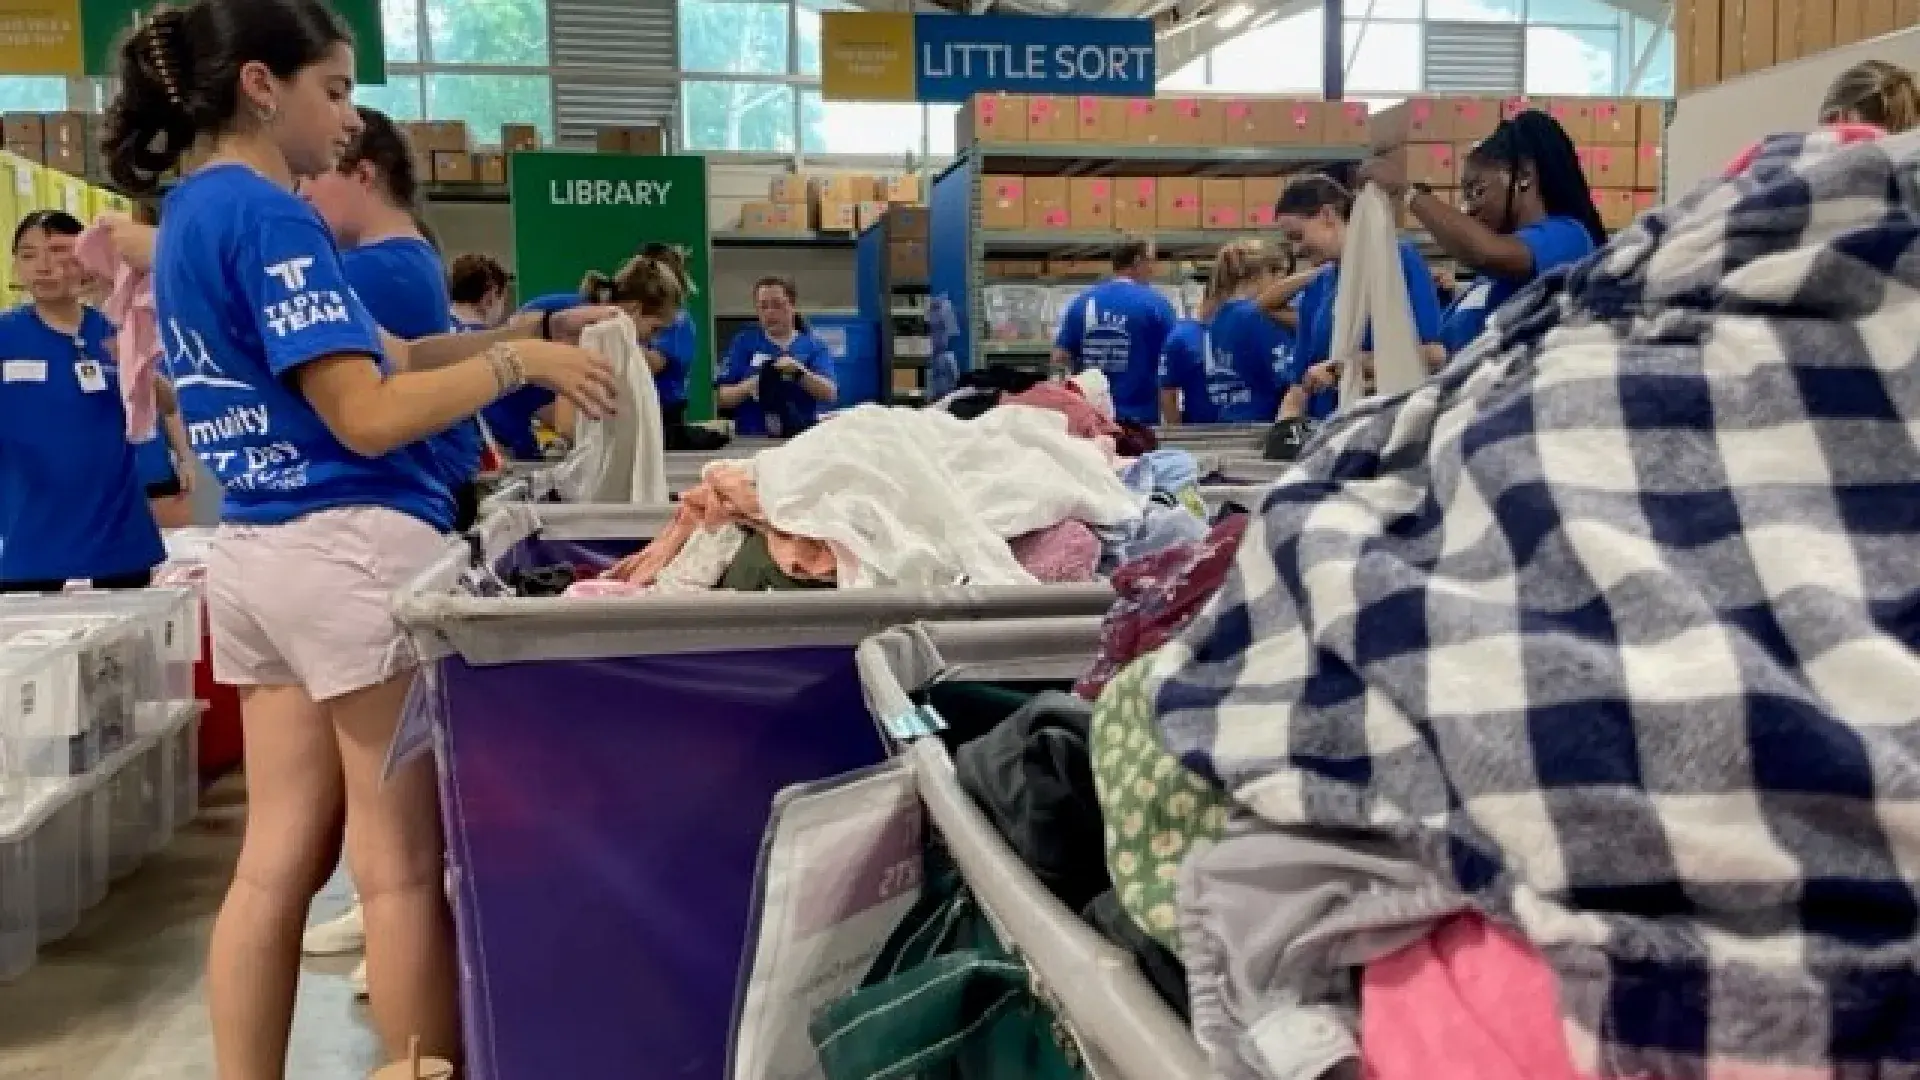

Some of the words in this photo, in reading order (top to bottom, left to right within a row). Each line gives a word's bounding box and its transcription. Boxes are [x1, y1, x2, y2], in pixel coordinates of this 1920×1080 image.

[922, 42, 1048, 79] LITTLE
[1054, 45, 1154, 81] SORT
[549, 179, 673, 206] LIBRARY
[267, 304, 349, 336] TEAM
